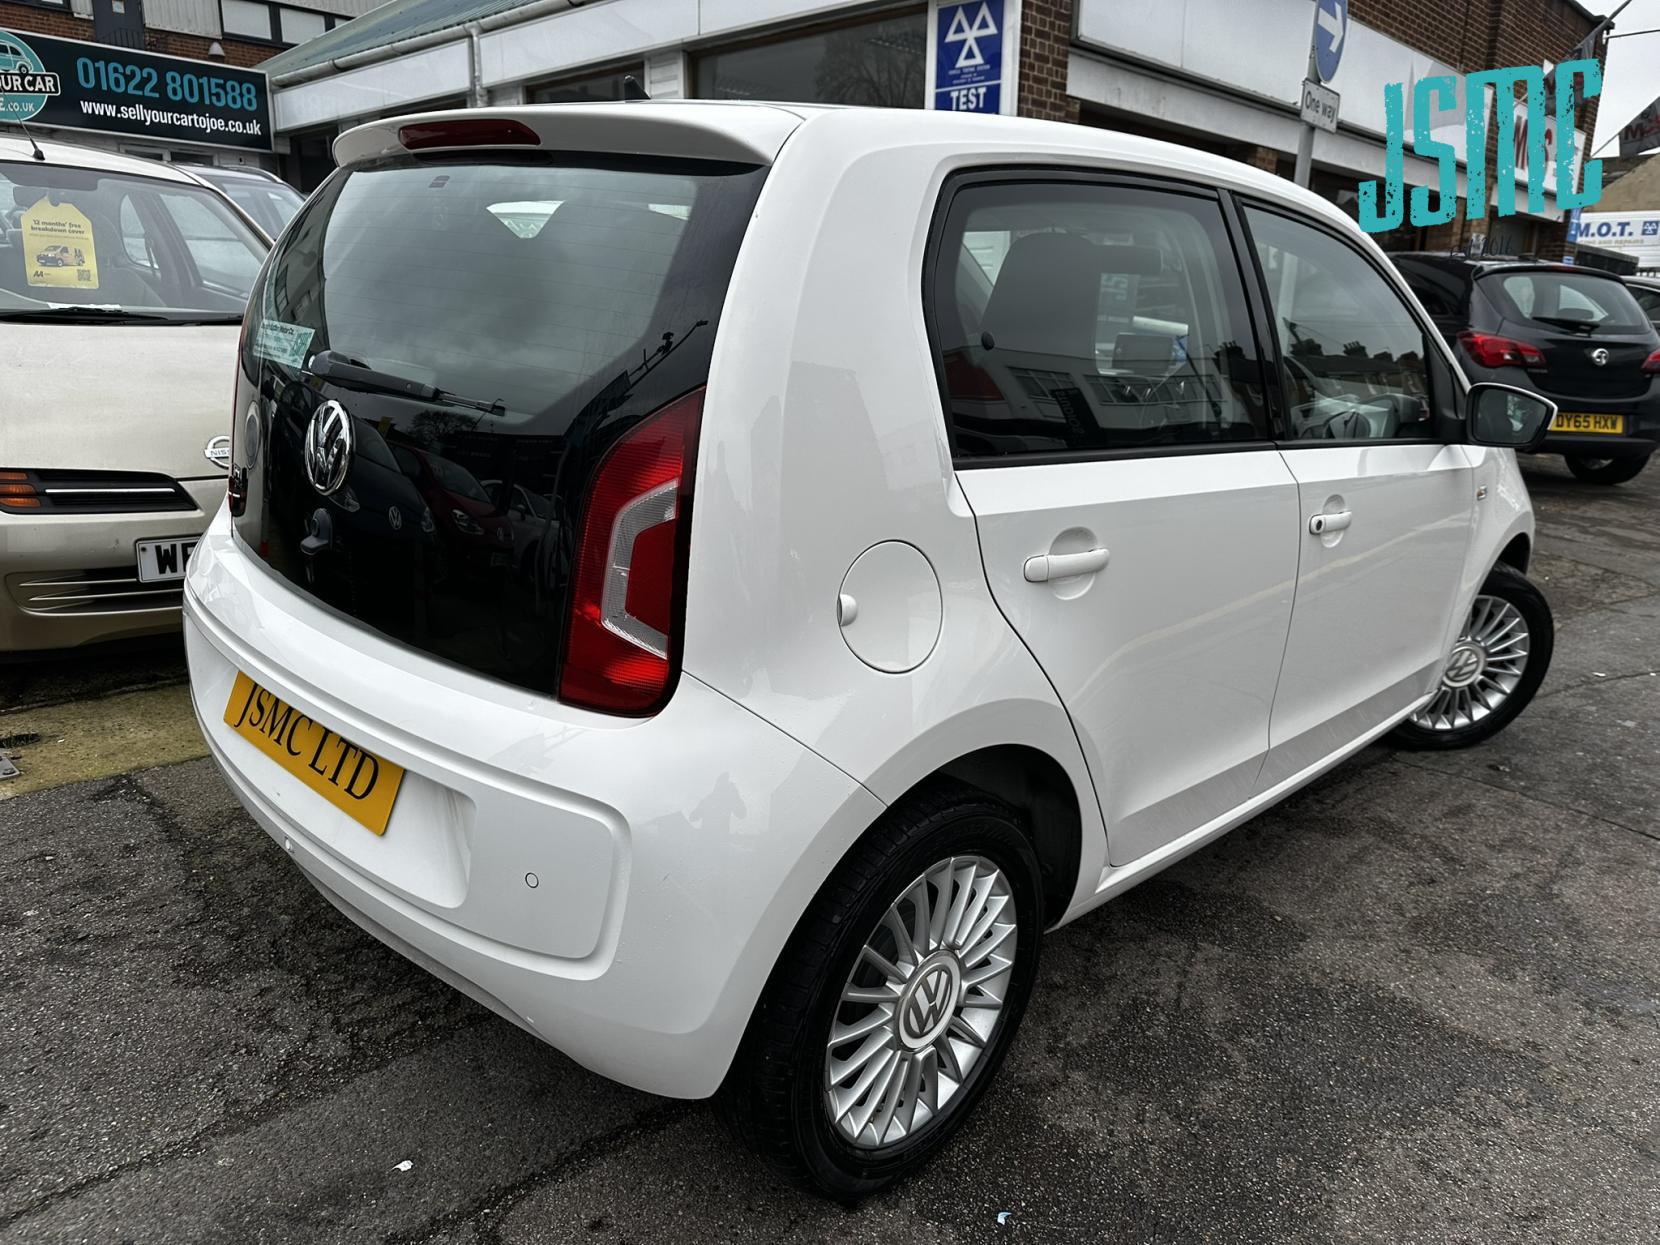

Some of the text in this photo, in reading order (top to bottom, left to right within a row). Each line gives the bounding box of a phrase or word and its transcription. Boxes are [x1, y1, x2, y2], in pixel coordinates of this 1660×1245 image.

[0, 75, 56, 92] UR CAR
[76, 57, 258, 111] 01622 801588
[950, 86, 987, 110] TEST
[1305, 91, 1337, 124] One way
[80, 101, 262, 136] www.sellyourcartojoe.co.uk
[1578, 222, 1634, 237] M.O.T.
[1556, 414, 1618, 430] DY65 HXW
[234, 682, 380, 800] JSMC LTD
